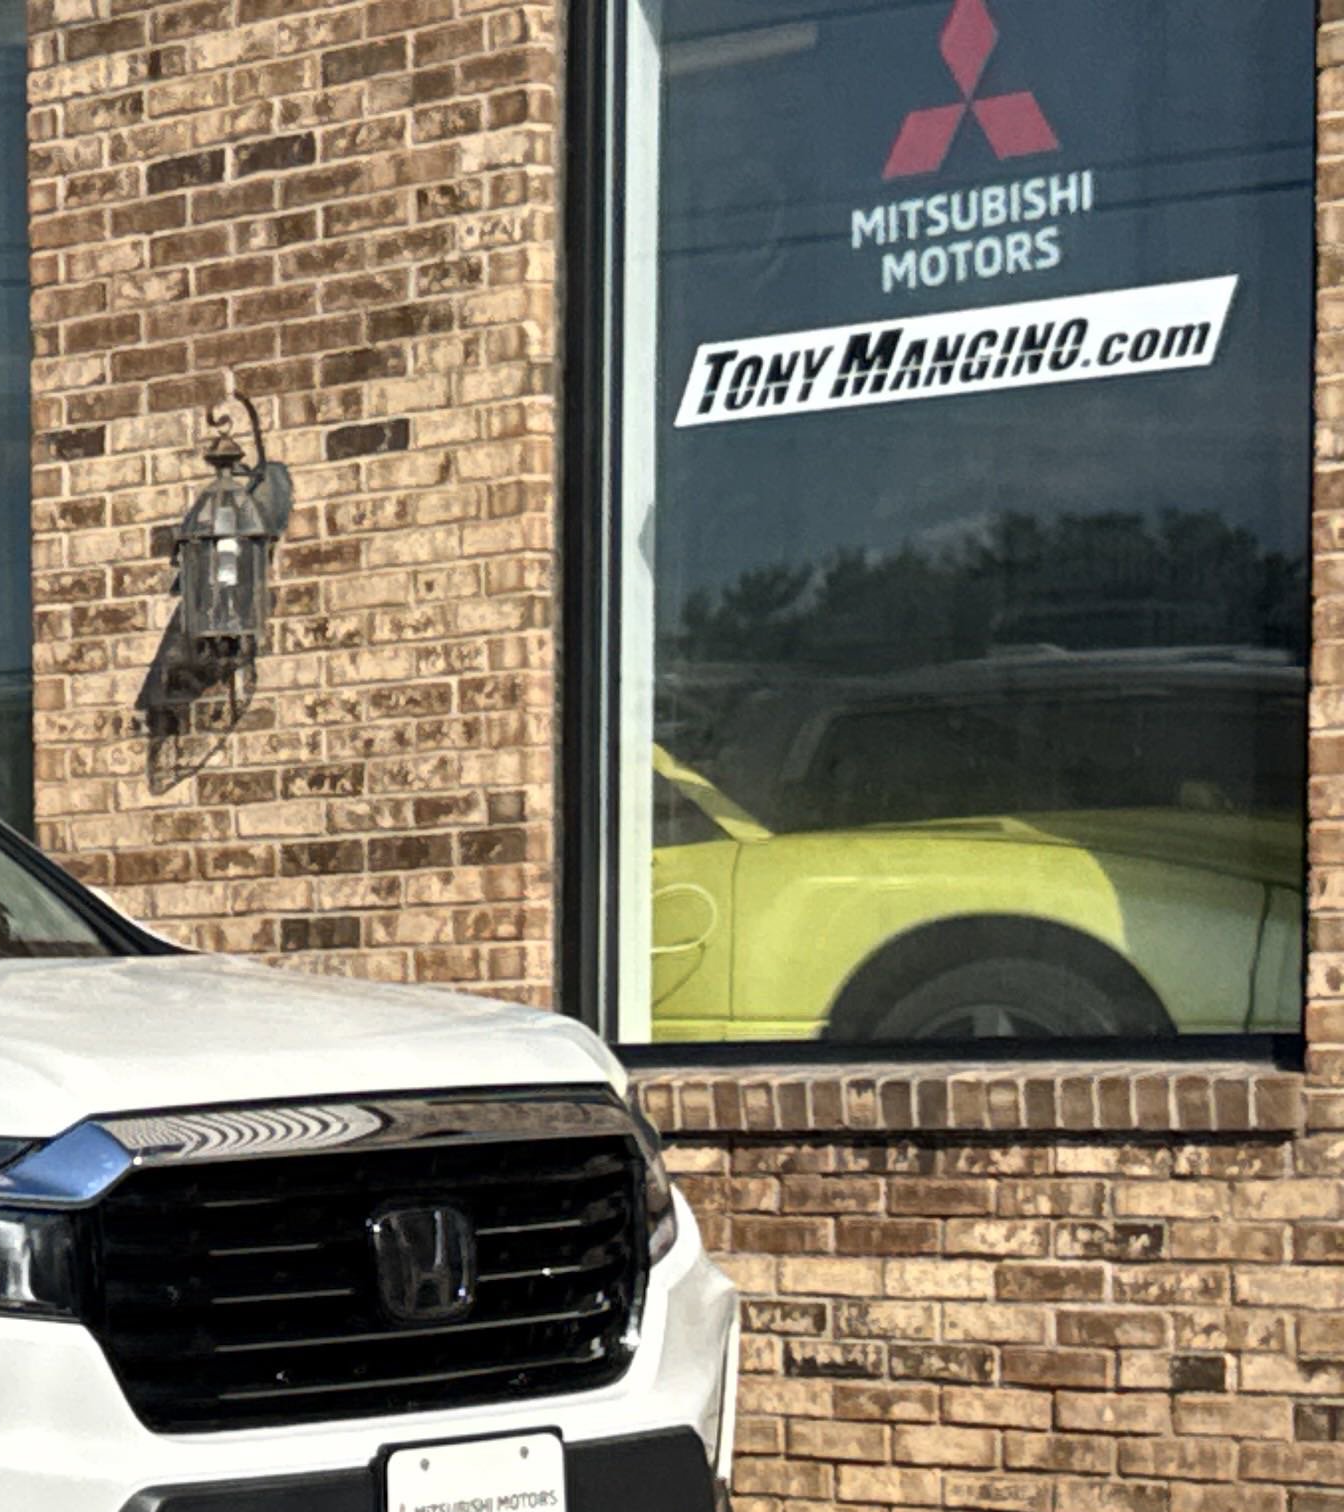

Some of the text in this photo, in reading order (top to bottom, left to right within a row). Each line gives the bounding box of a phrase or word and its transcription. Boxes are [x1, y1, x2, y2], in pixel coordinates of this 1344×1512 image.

[852, 170, 1093, 248] MITSUBISHI
[882, 227, 1060, 291] MOTORS
[497, 1489, 558, 1512] MOTORS
